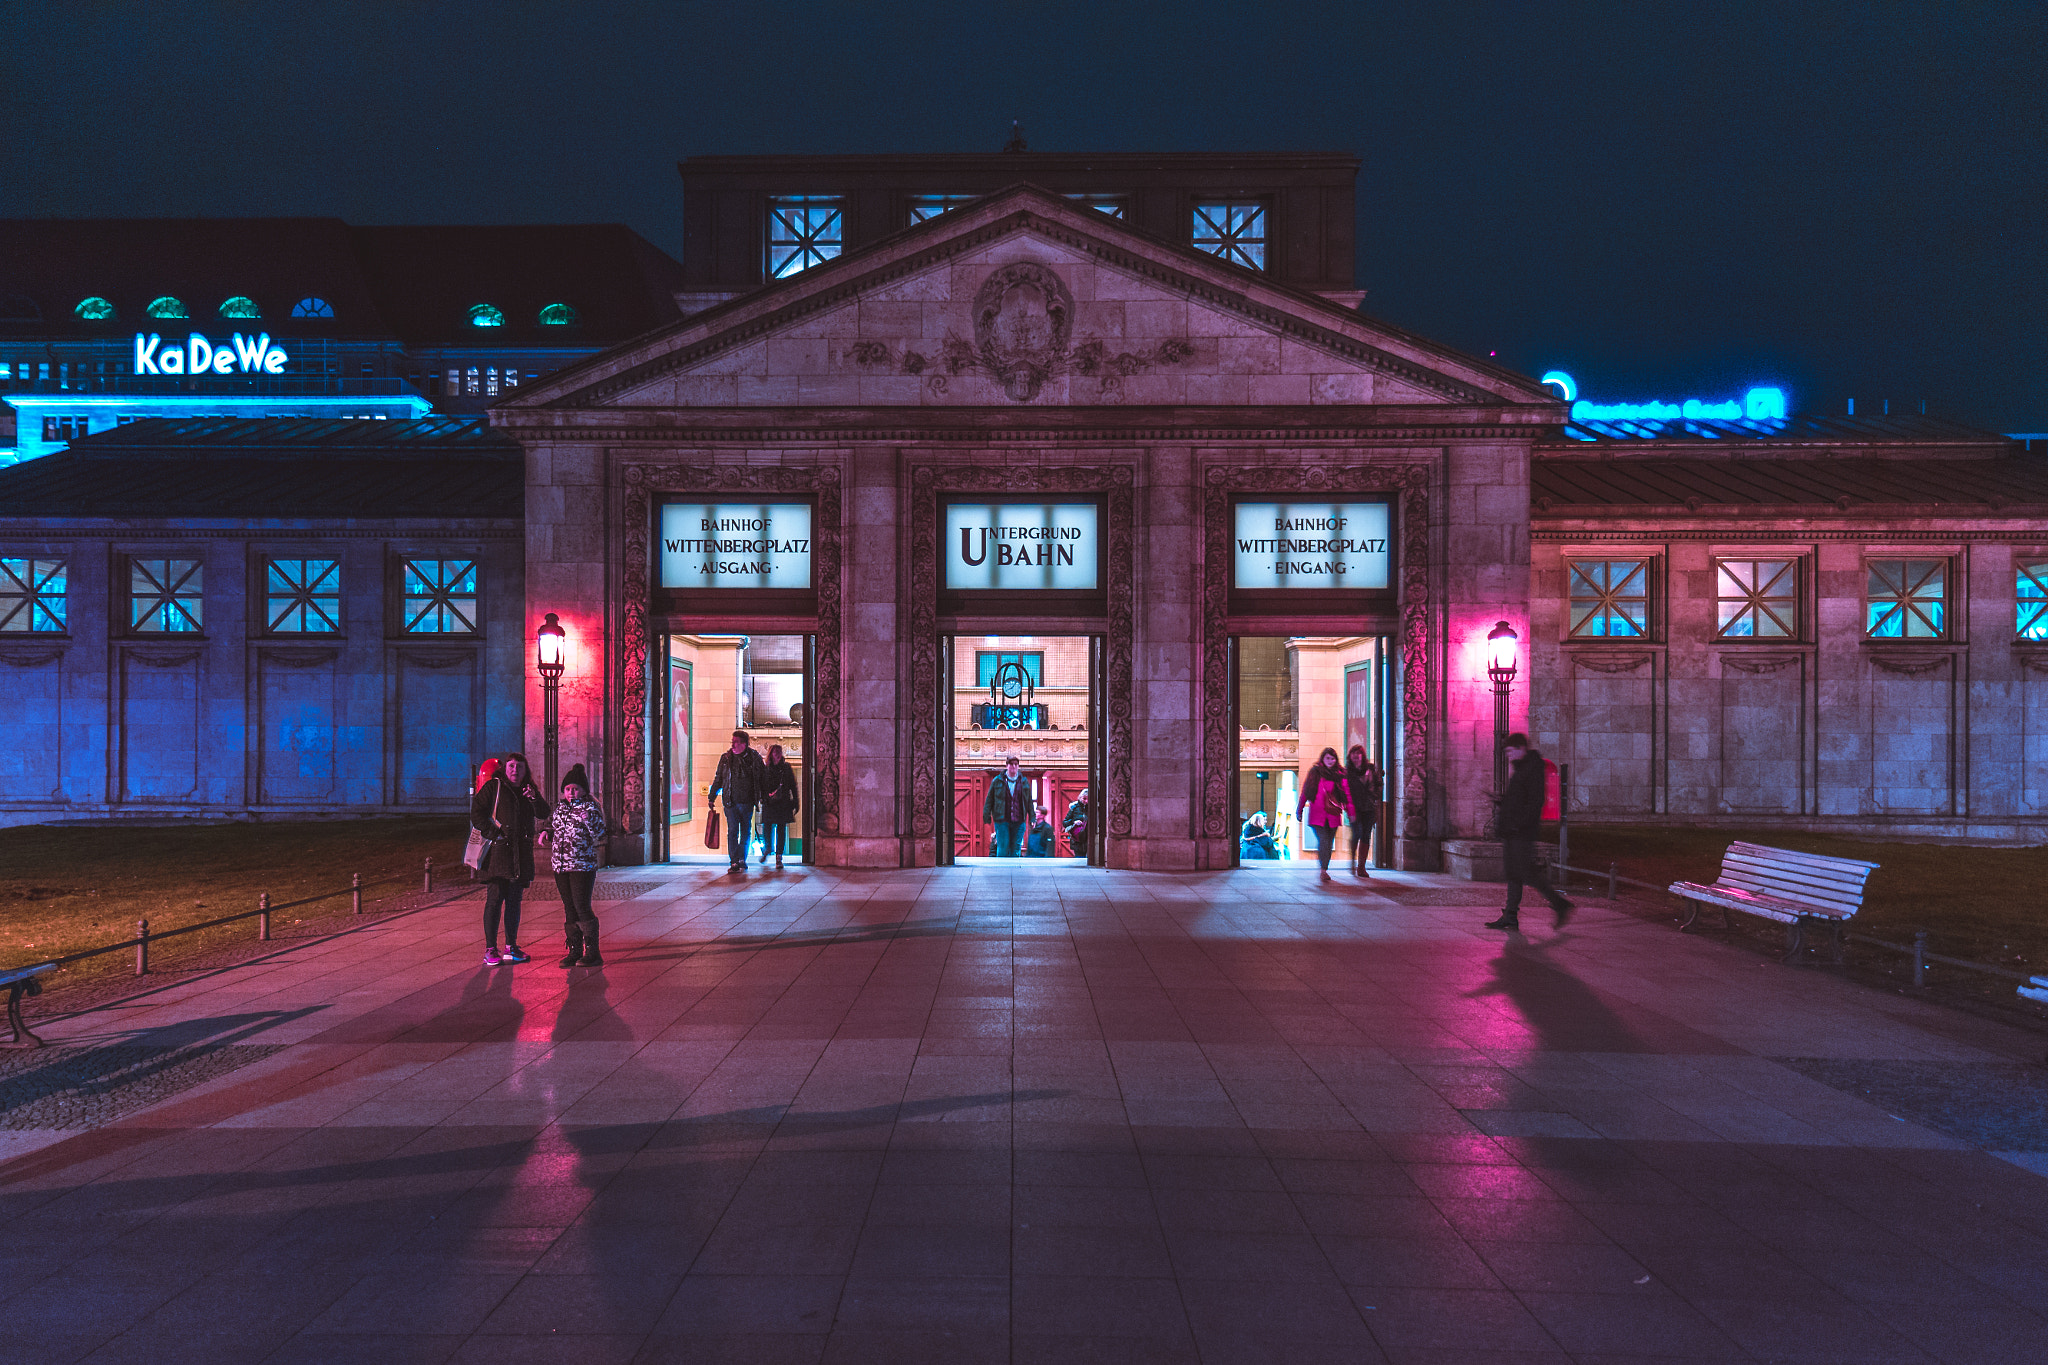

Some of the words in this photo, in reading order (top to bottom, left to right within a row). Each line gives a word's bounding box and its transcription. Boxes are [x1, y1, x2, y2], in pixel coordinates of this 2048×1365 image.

[134, 332, 289, 375] KaDeWe
[701, 519, 772, 531] BAHNHOF
[1275, 518, 1348, 531] BAHNHOF
[665, 539, 809, 553] WITTENBERGPLATZ
[1237, 539, 1386, 553] WITTENBERGPLATZ
[997, 543, 1074, 566] BAHN
[700, 561, 772, 574] AUSGANG
[1275, 561, 1347, 574] EINGANG
